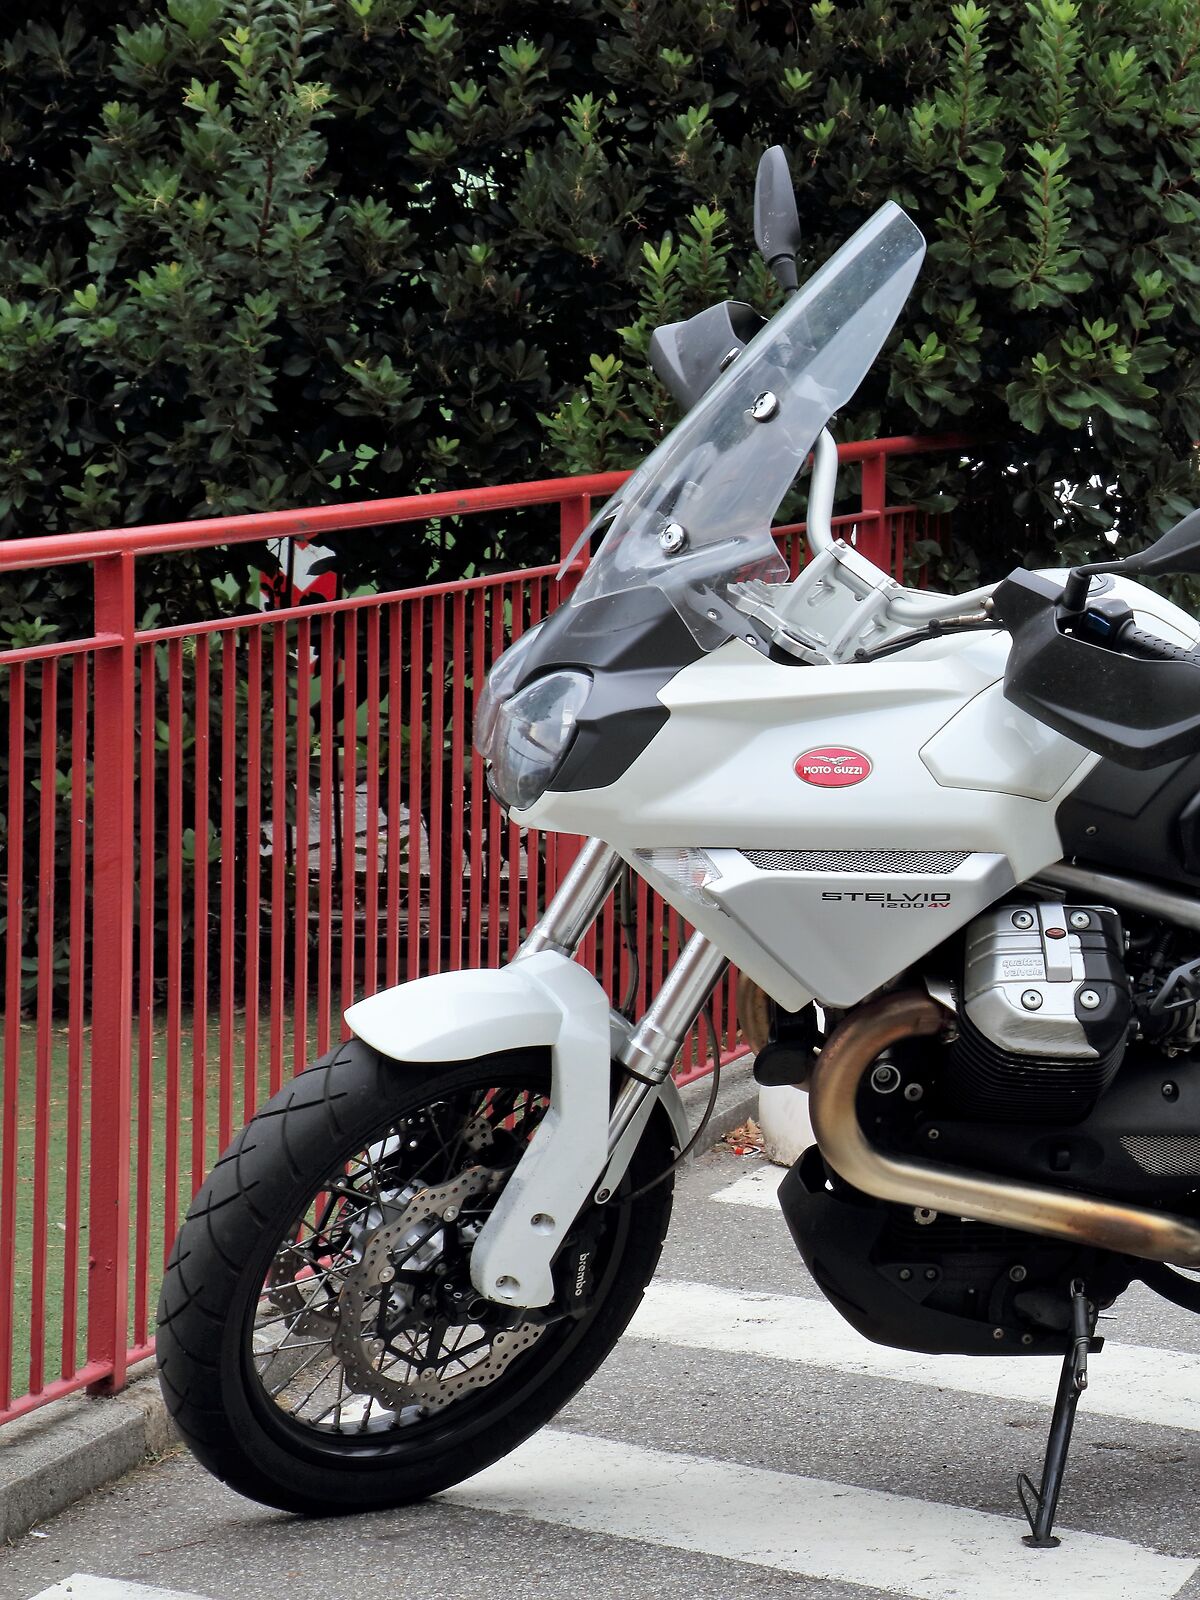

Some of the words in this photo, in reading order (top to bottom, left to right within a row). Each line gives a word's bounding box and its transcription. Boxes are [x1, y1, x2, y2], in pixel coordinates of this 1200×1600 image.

[803, 765, 832, 774] MOTO
[834, 765, 863, 775] GUZZI
[821, 892, 951, 902] STELVIO
[574, 1252, 590, 1297] brembo
